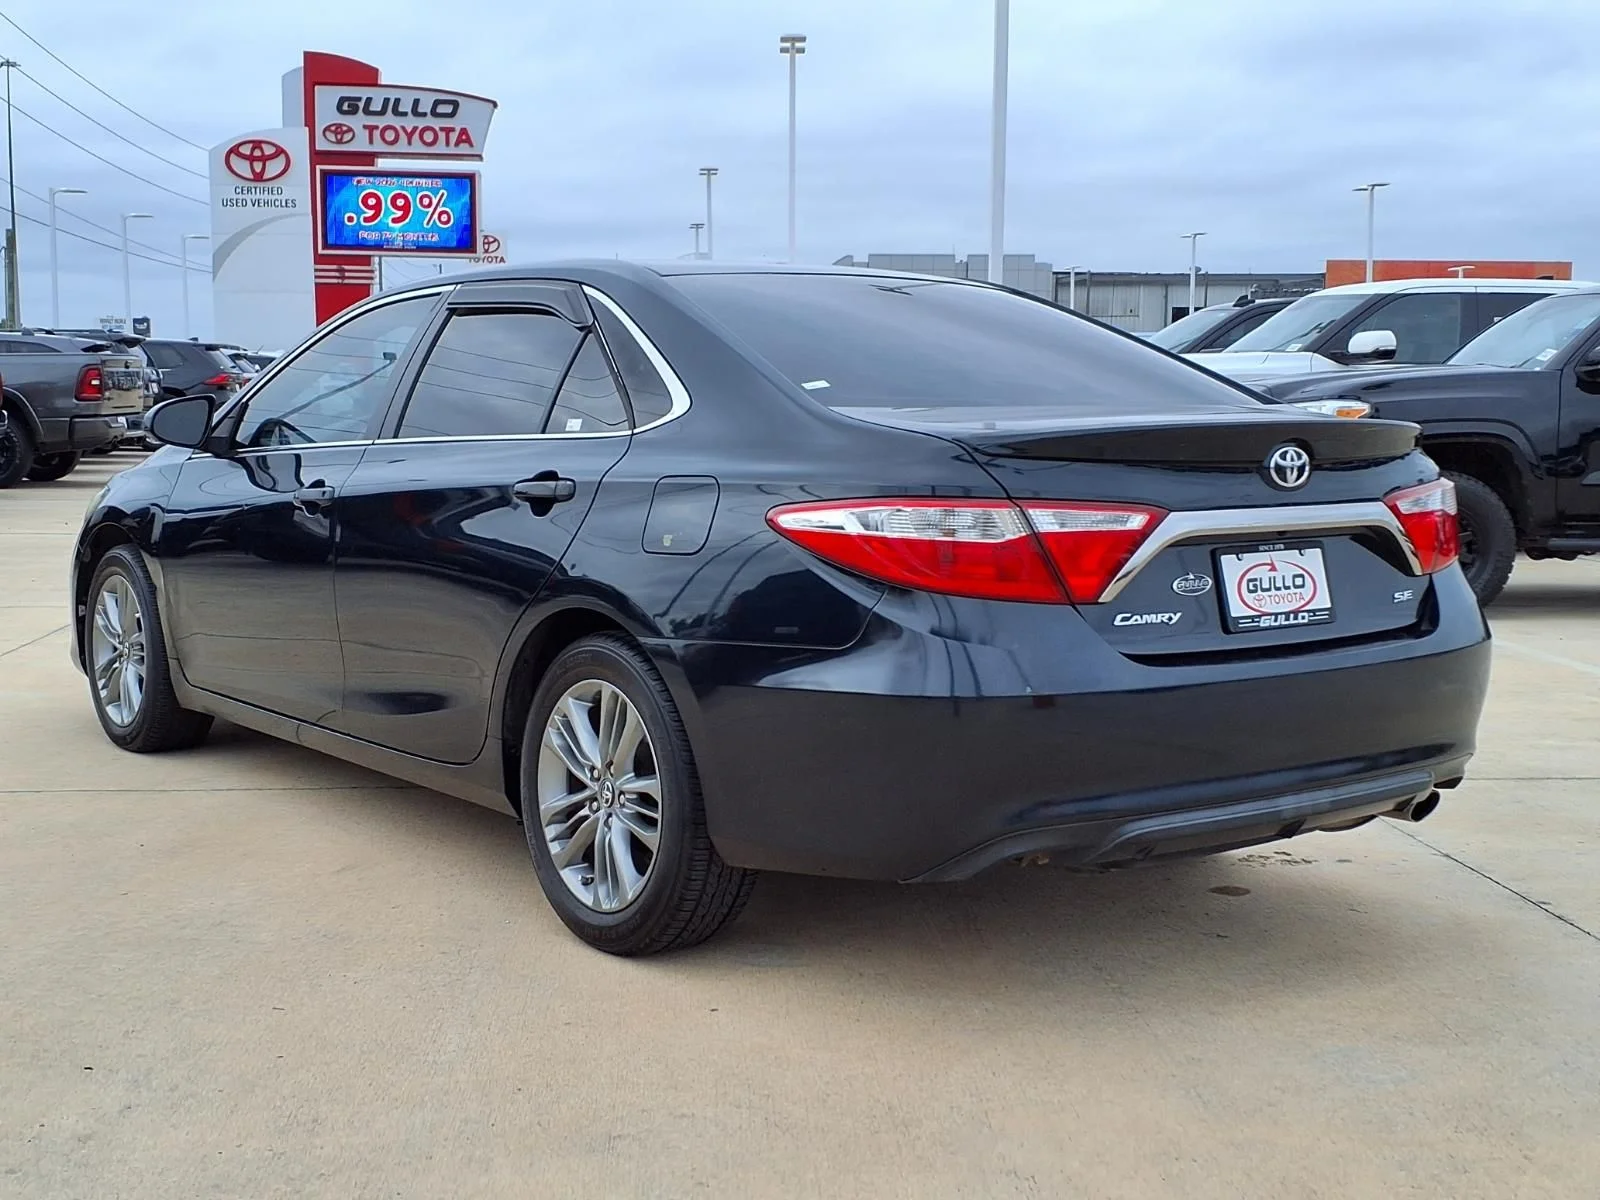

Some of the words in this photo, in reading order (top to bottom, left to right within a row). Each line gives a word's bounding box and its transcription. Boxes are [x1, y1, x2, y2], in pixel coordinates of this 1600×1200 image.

[336, 96, 460, 118] GULLO
[362, 124, 474, 147] TOYOTA
[234, 185, 283, 196] CERTIFIED
[221, 198, 248, 208] USED
[250, 198, 297, 208] VEHICLES
[344, 189, 453, 228] .99%
[1176, 578, 1209, 591] GULLO
[1246, 573, 1306, 594] GULLO
[1268, 591, 1306, 605] TOYOTA
[1394, 590, 1414, 603] SE
[1113, 612, 1182, 626] CAMRY
[1259, 612, 1309, 627] GULLO
